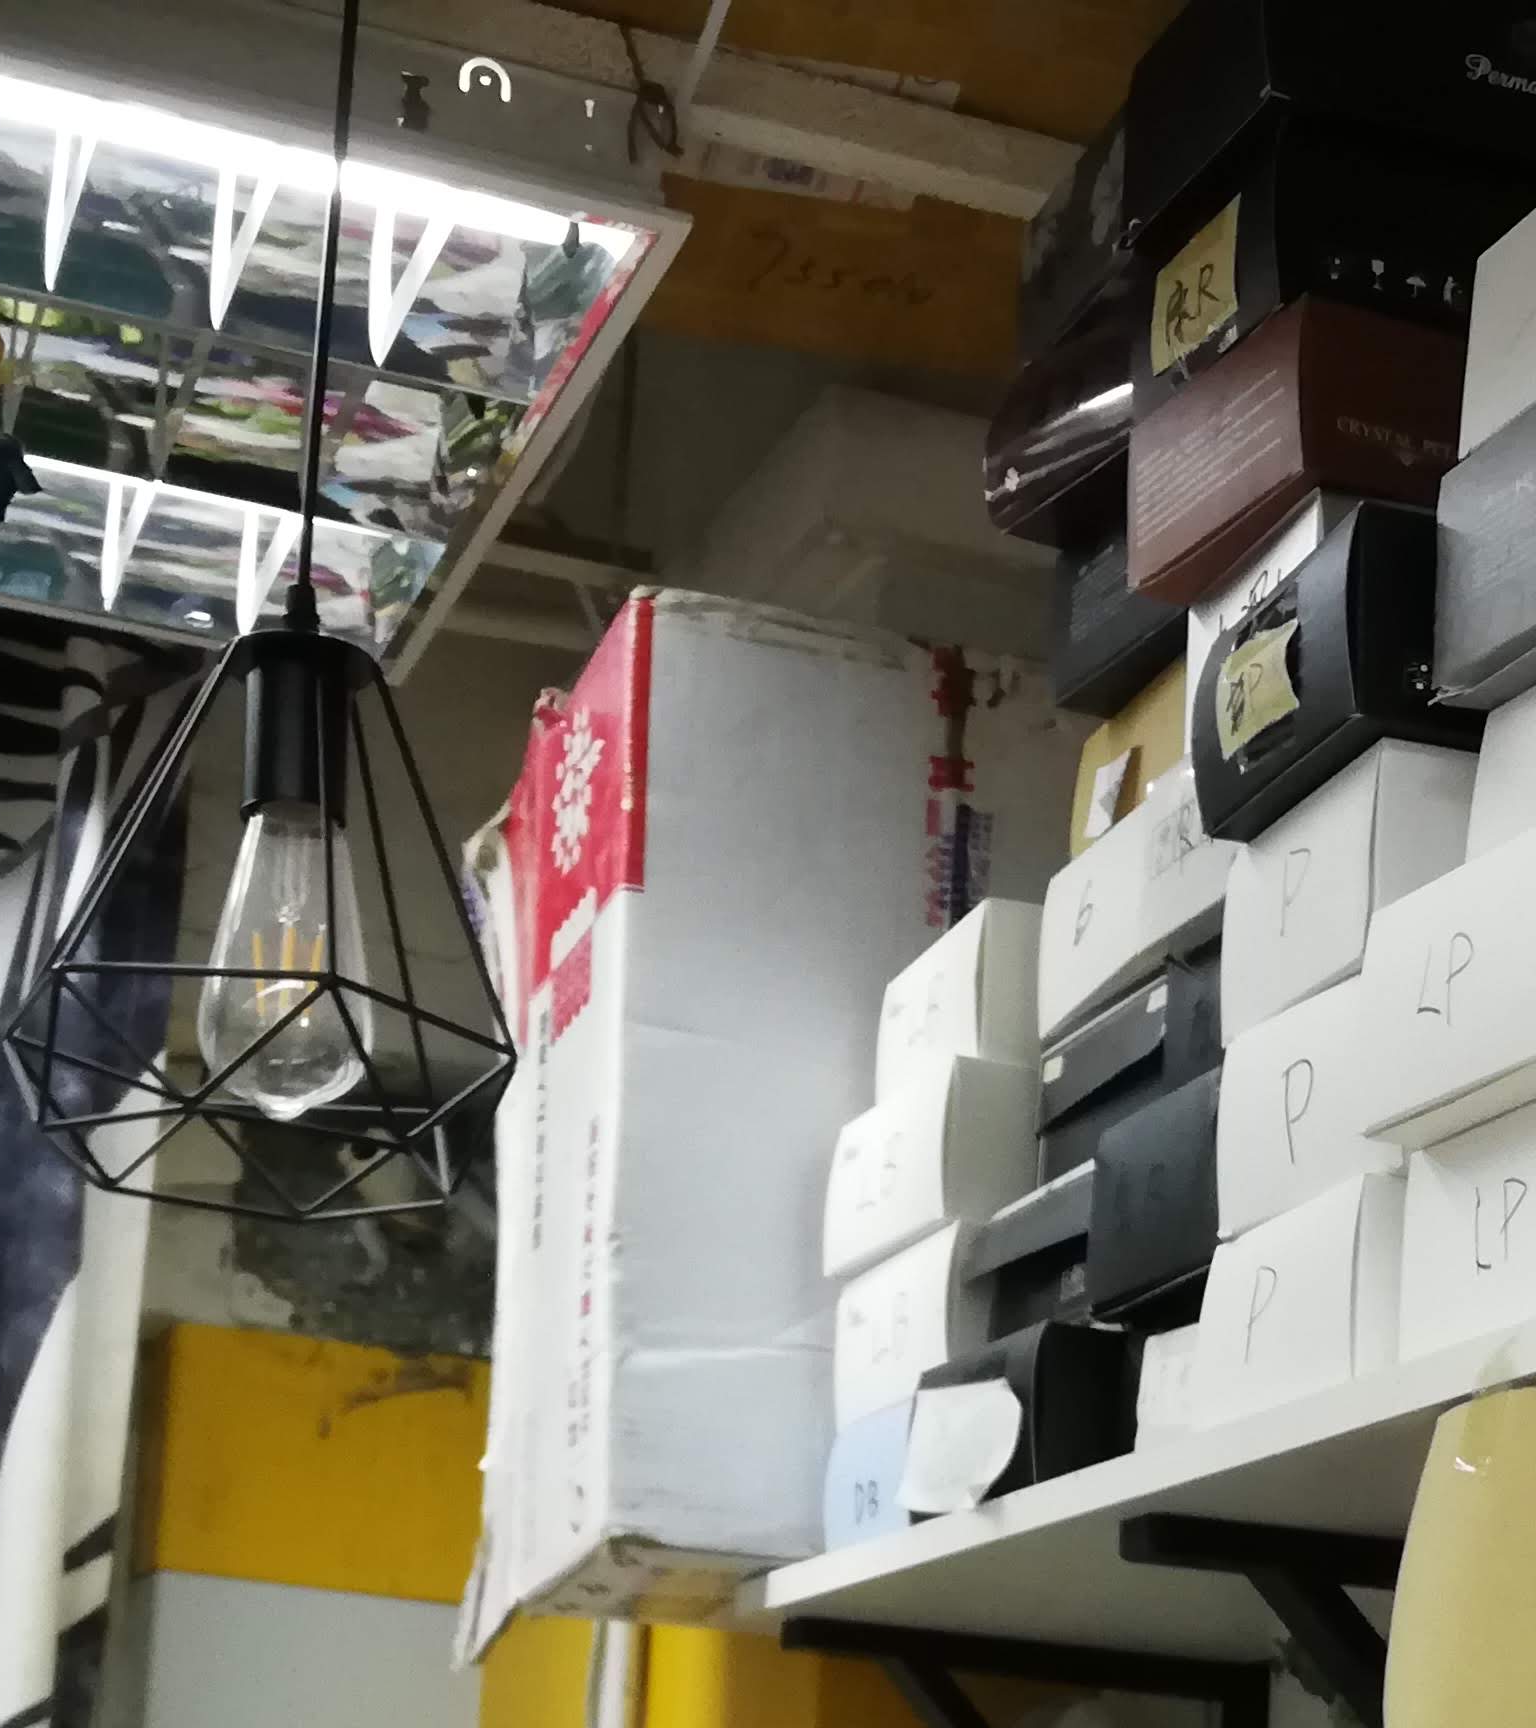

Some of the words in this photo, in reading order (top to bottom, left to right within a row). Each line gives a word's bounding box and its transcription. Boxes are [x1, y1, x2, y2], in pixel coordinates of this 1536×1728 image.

[1279, 846, 1313, 938] P
[1416, 930, 1475, 1026] LP
[1281, 1058, 1314, 1165] P
[1472, 1175, 1529, 1277] LP
[1244, 1264, 1278, 1365] P
